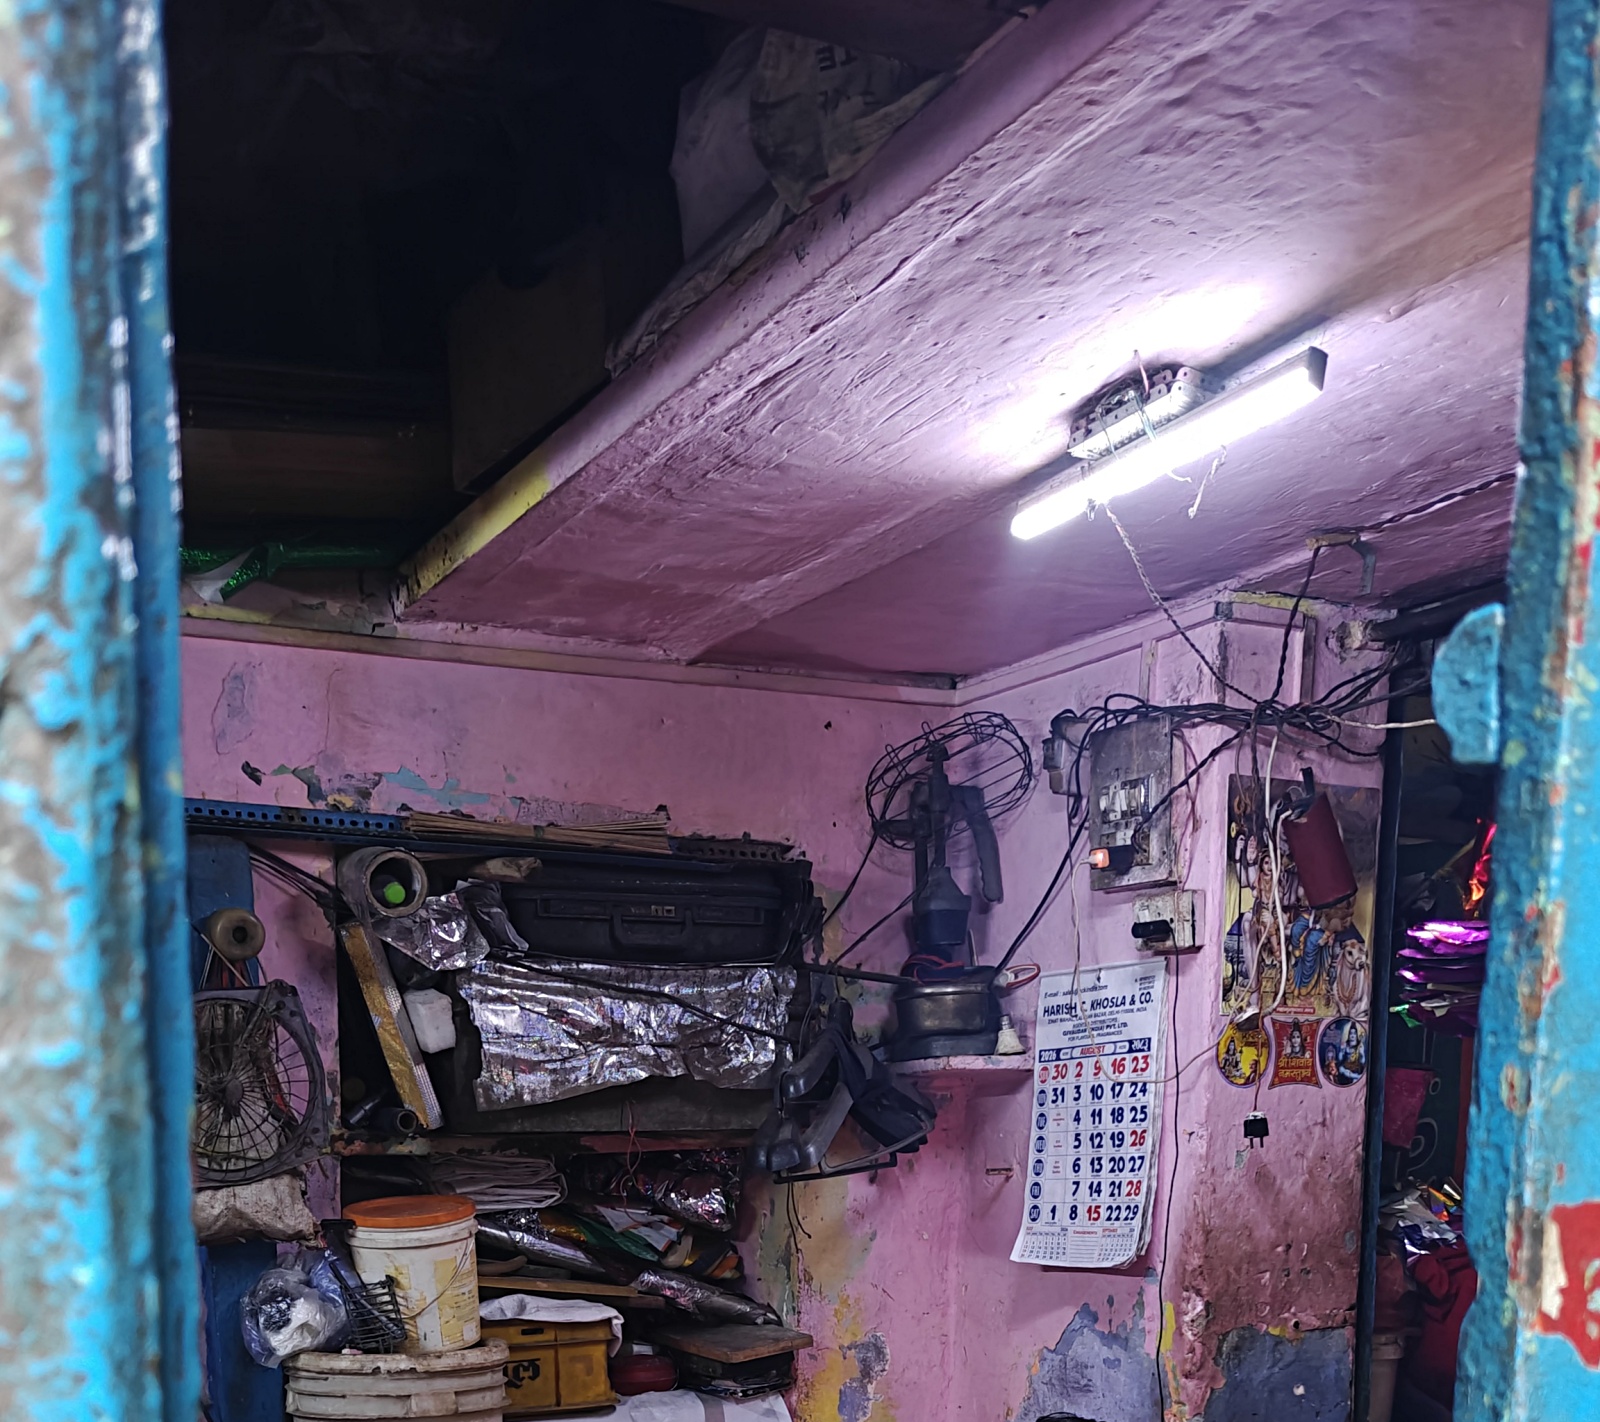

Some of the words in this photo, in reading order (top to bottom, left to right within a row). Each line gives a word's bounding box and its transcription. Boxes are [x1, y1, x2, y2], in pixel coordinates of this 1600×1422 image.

[1043, 1002, 1077, 1017] HARISH
[1090, 995, 1126, 1011] KHOSLA
[1129, 994, 1136, 1006] &
[1139, 991, 1153, 1004] CO.
[1040, 1049, 1057, 1061] 2026
[1080, 1045, 1106, 1055] AUGUST
[1052, 1063, 1068, 1080] 30
[1075, 1061, 1083, 1078] 2
[1093, 1060, 1102, 1077] 9
[1111, 1057, 1126, 1075] 16
[1131, 1055, 1150, 1073] 23
[1051, 1087, 1065, 1104] 31
[1073, 1085, 1081, 1101] 3
[1090, 1083, 1104, 1101] 10
[1111, 1082, 1124, 1099] 17
[1129, 1082, 1148, 1098] 24
[1073, 1109, 1081, 1126] 4
[1091, 1108, 1102, 1125] 11
[1110, 1106, 1124, 1124] 18
[1130, 1105, 1148, 1123] 25
[1073, 1133, 1081, 1149] 5
[1089, 1132, 1103, 1149] 12
[1109, 1131, 1125, 1148] 19
[1129, 1129, 1147, 1147] 26
[1072, 1157, 1081, 1173] 6
[1090, 1156, 1103, 1173] 13
[1108, 1156, 1125, 1173] 20
[1128, 1155, 1145, 1172] 27
[1072, 1181, 1080, 1196] 7
[1088, 1181, 1102, 1197] 14
[1108, 1180, 1122, 1197] 21
[1125, 1180, 1142, 1197] 28
[1050, 1205, 1056, 1220] 1
[1069, 1204, 1078, 1220] 8
[1086, 1205, 1101, 1221] 15
[1105, 1205, 1121, 1221] 22
[1122, 1204, 1139, 1221] 29
